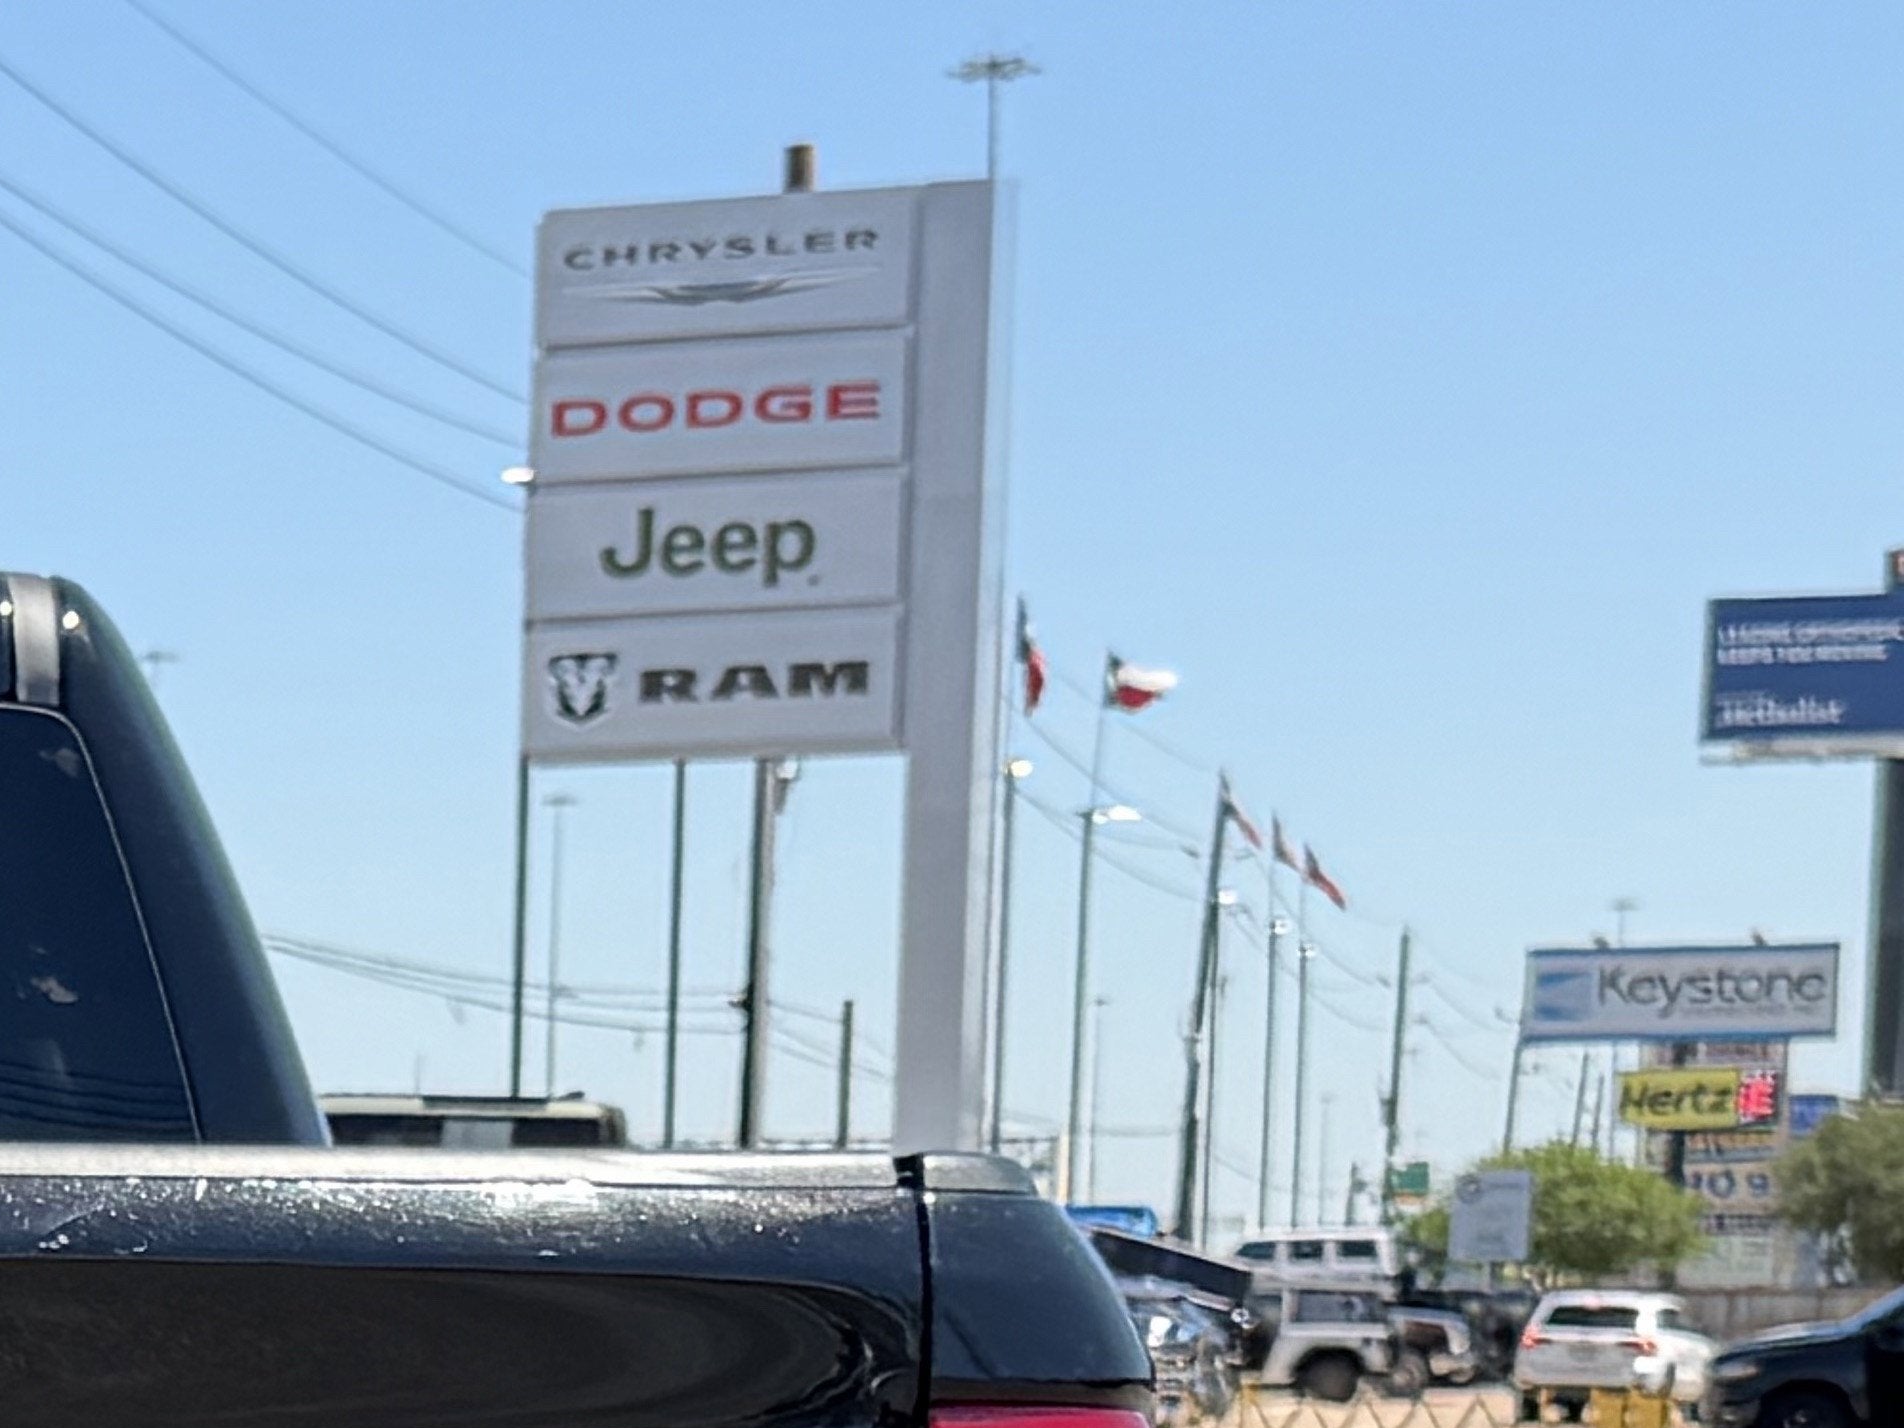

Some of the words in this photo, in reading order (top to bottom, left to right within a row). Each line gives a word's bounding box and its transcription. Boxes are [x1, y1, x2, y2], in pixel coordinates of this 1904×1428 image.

[563, 228, 881, 271] CHRYSLER
[550, 380, 882, 439] DODGE
[600, 507, 817, 588] Jeep
[637, 660, 871, 705] RAM
[1597, 964, 1828, 1020] Keystone
[1620, 1081, 1734, 1117] Hertz
